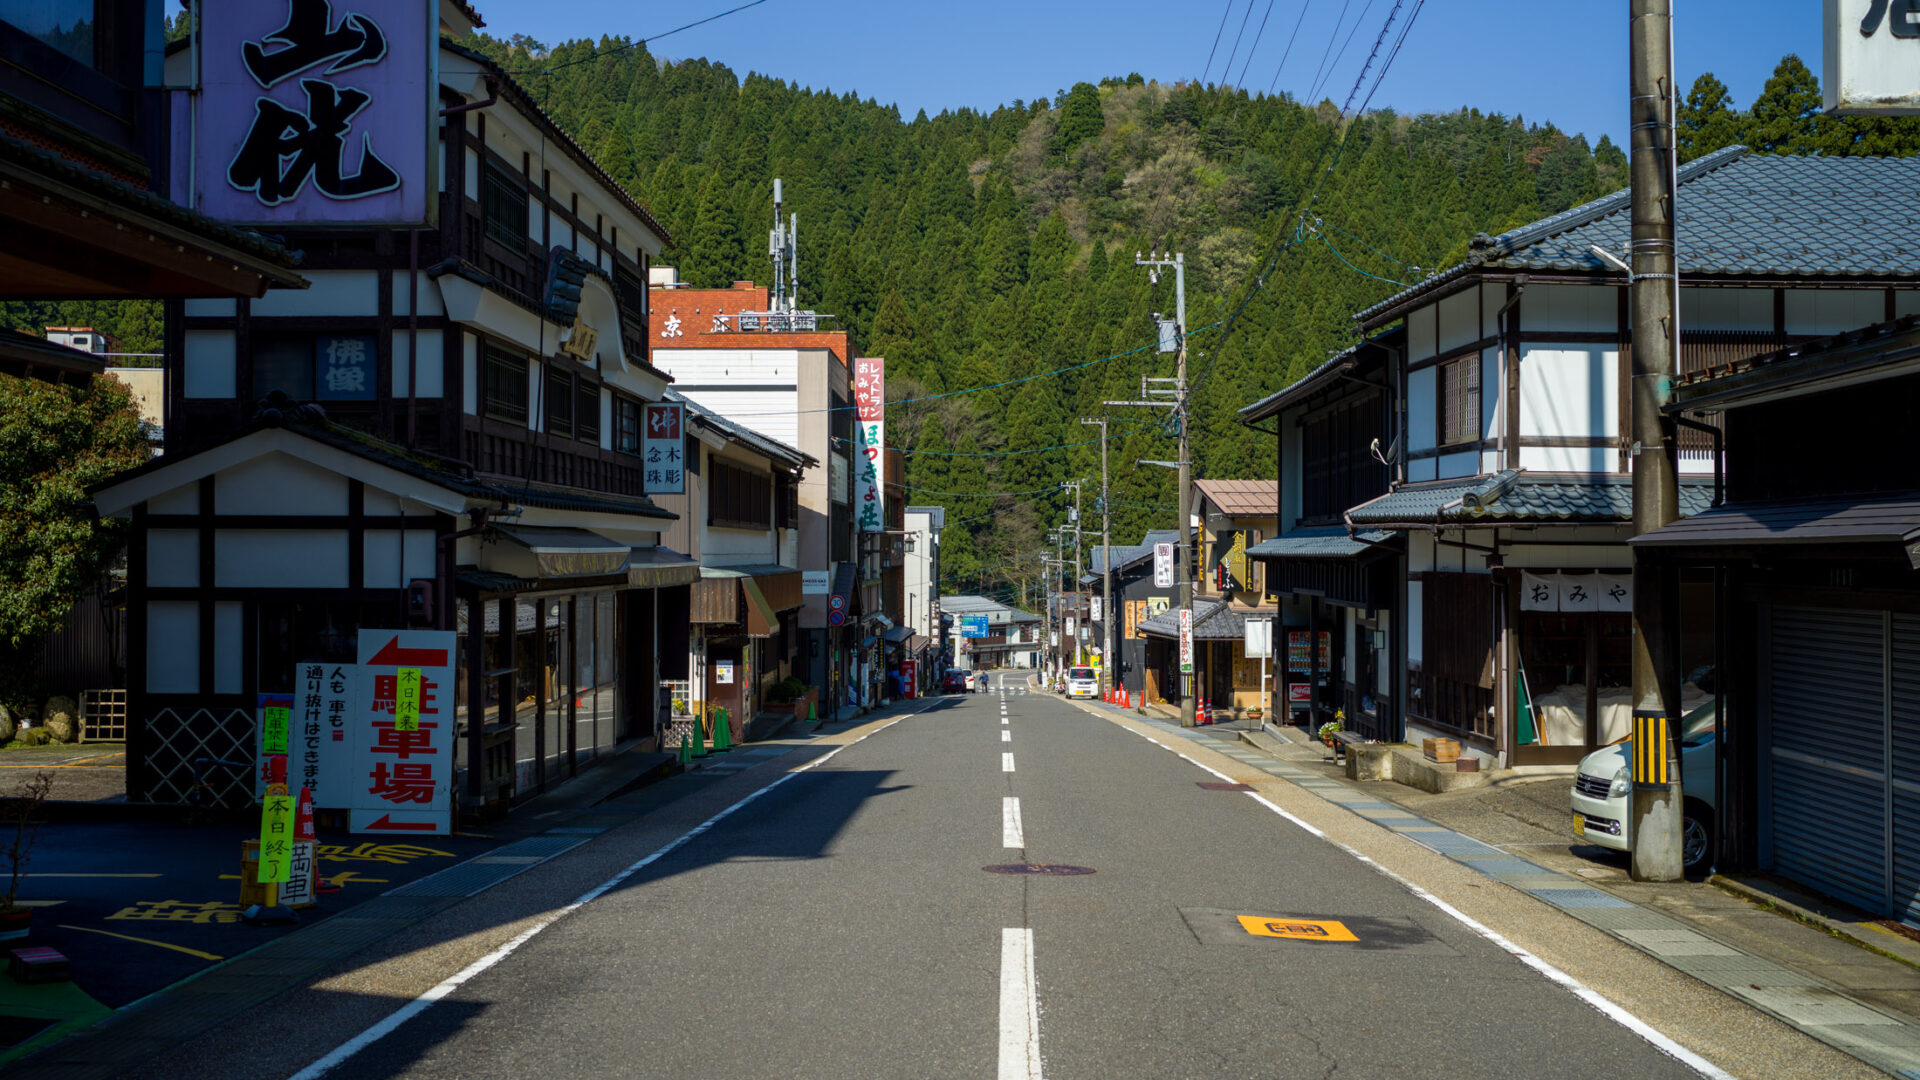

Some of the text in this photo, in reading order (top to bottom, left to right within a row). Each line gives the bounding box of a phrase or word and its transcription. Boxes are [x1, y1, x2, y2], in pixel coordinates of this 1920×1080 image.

[858, 362, 869, 419] おみやげ
[869, 362, 881, 419] レストラン
[646, 446, 662, 485] 念珠
[665, 446, 681, 485] 木彫
[1531, 584, 1627, 604] おみや
[265, 708, 286, 753] 駐車禁止
[265, 798, 290, 879] 本日終了
